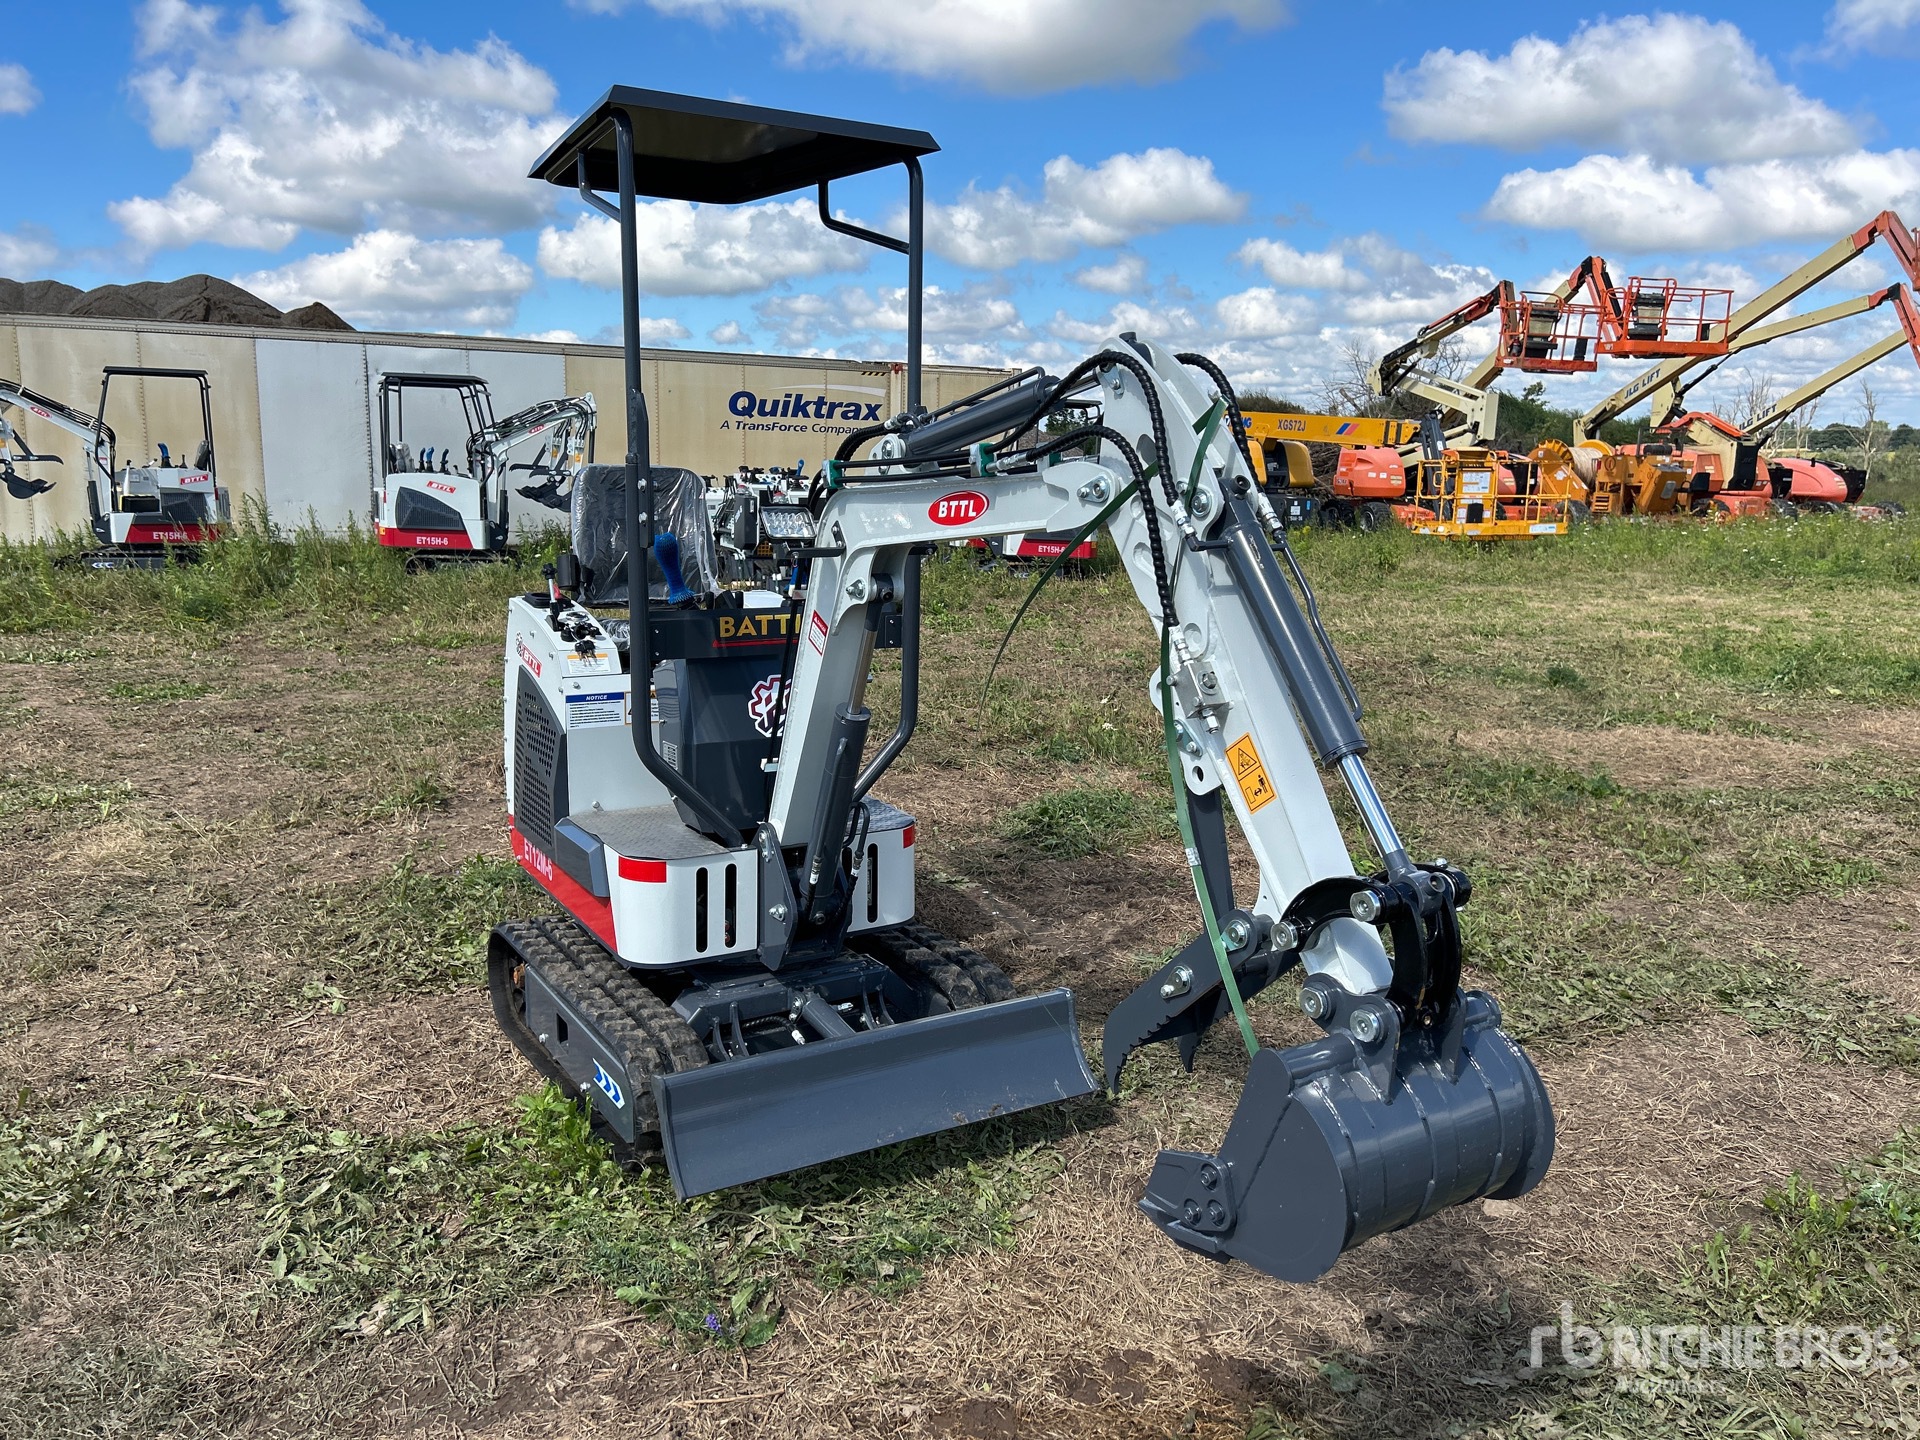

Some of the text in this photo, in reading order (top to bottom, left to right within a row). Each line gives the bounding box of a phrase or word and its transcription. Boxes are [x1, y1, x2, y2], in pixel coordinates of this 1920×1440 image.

[1624, 368, 1661, 399] JLG LIFT
[728, 390, 883, 422] Quiktrax
[1756, 403, 1777, 421] LIFT
[720, 420, 730, 430] A
[735, 420, 808, 433] TransForce
[1277, 419, 1307, 432] XGS72J
[184, 475, 205, 484] BTTL
[431, 482, 452, 492] BTTL
[938, 499, 977, 518] BTTL
[416, 536, 449, 546] ET15H-6
[523, 649, 540, 674] BTTL
[523, 837, 553, 881] ET12M-6
